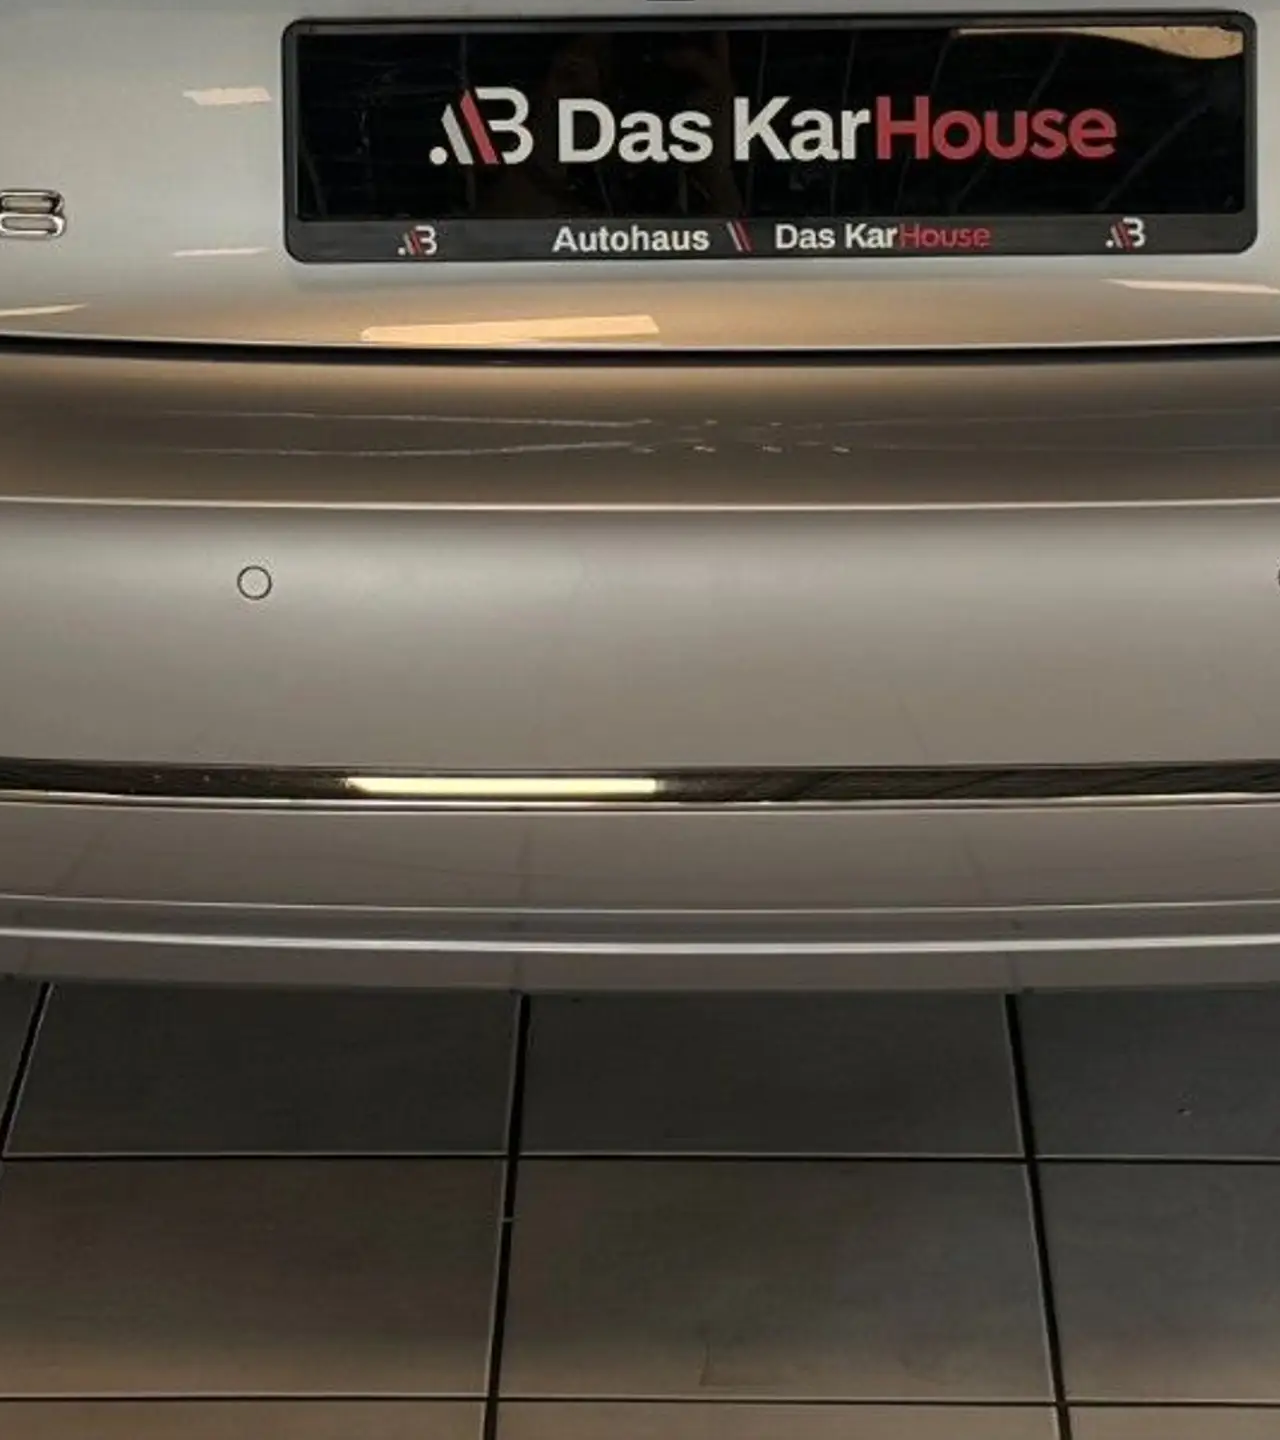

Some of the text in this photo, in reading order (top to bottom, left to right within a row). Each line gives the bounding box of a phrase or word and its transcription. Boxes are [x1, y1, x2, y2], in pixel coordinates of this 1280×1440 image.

[557, 95, 1118, 163] Das KarHouse
[551, 222, 992, 253] Autohaus Das KarHouse
